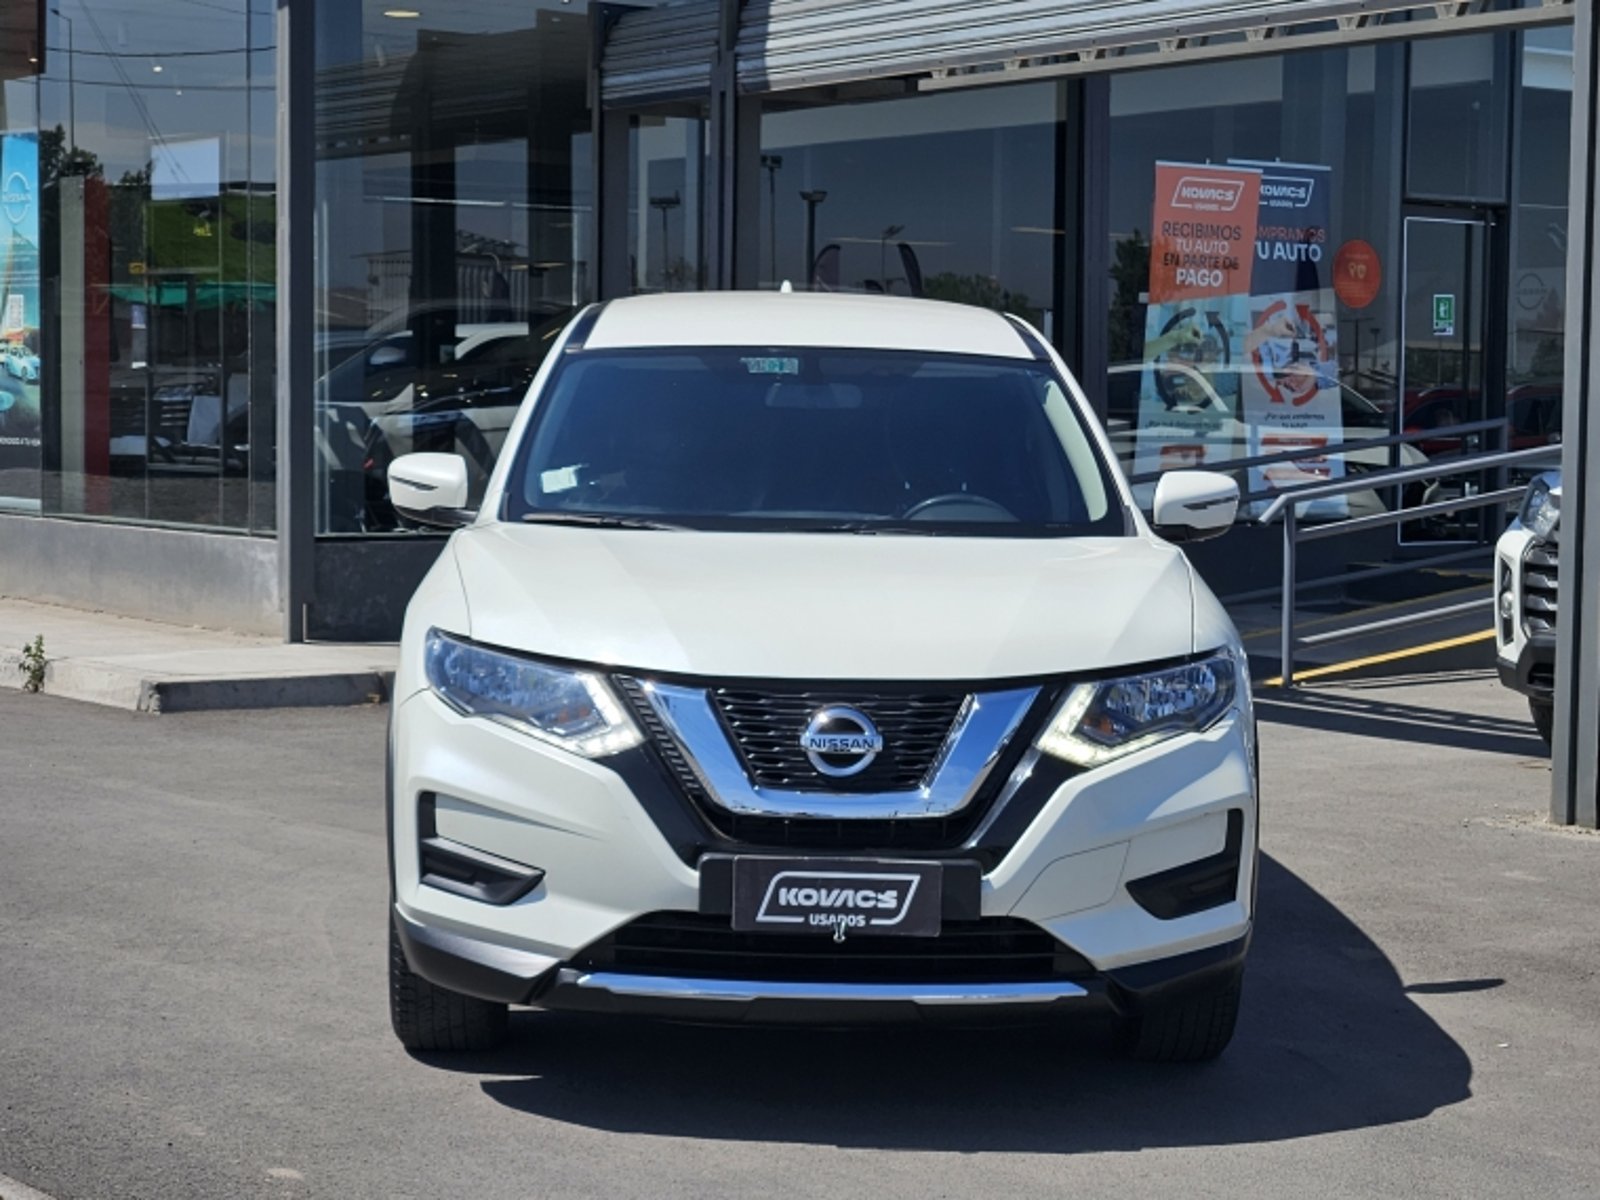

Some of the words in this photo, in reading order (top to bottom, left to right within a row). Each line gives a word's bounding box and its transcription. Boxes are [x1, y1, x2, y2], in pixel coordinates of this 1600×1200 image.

[1162, 220, 1242, 241] RECIBIMOS
[1258, 227, 1326, 243] MPRAMOS
[1176, 238, 1192, 254] TU
[1195, 239, 1229, 256] AUTO
[1273, 241, 1322, 262] AUTO
[1163, 252, 1180, 267] EN
[1183, 253, 1220, 270] PARTE
[1222, 256, 1239, 270] DE
[1176, 268, 1224, 287] PAGO
[810, 738, 874, 749] NISSAN
[779, 887, 898, 909] KOVACS
